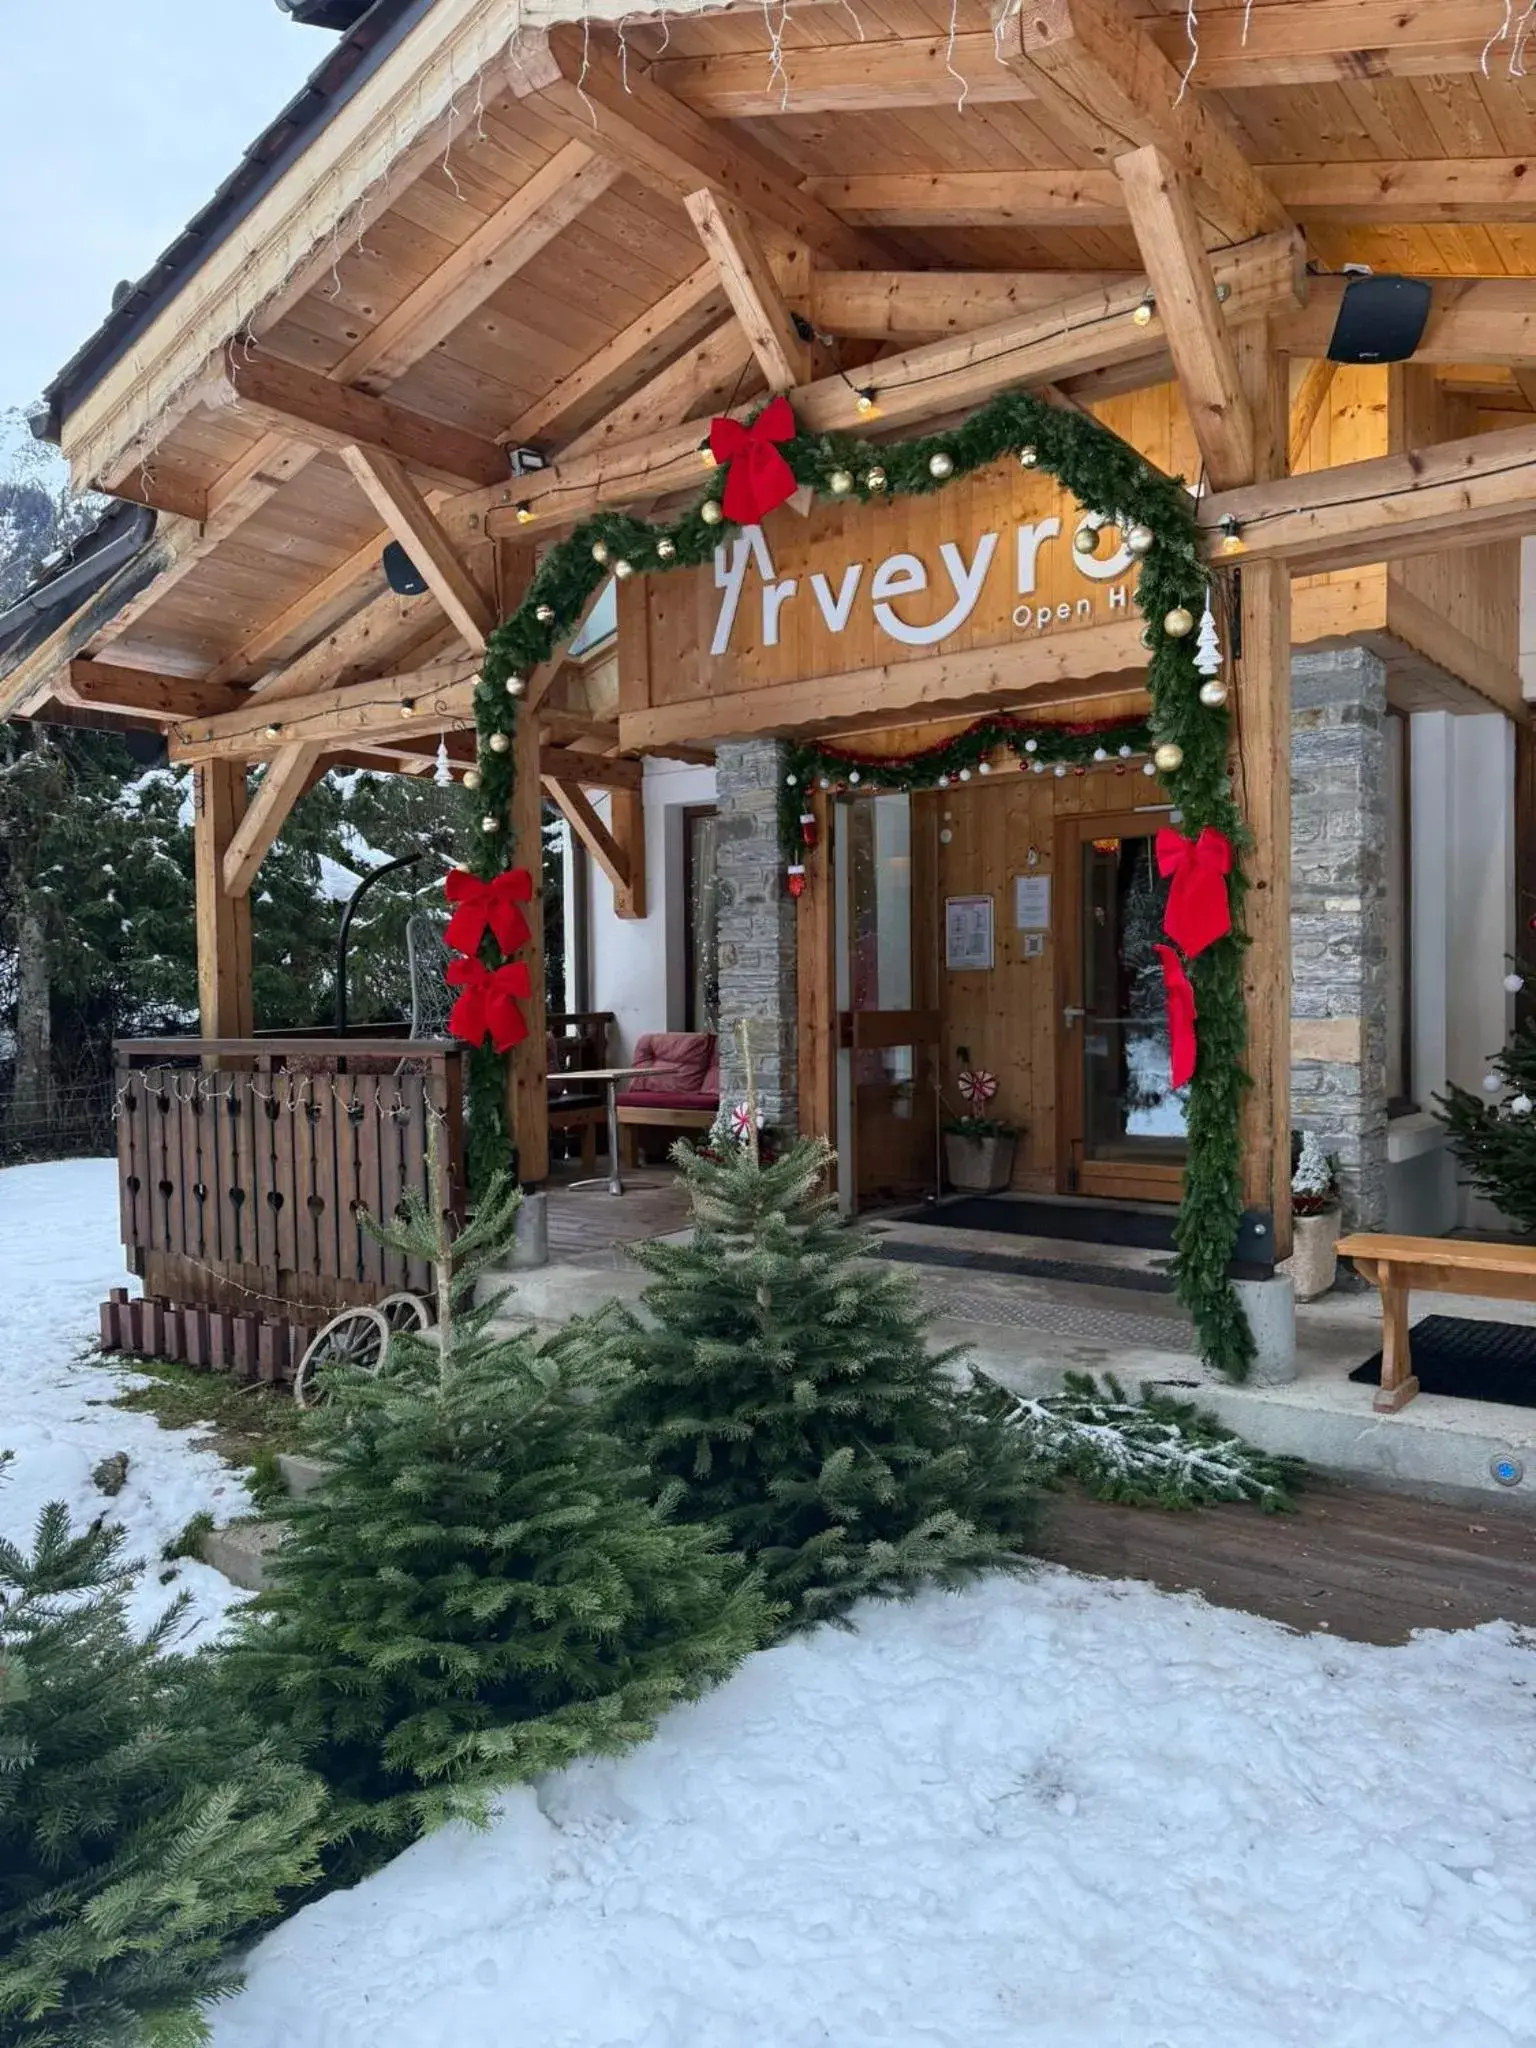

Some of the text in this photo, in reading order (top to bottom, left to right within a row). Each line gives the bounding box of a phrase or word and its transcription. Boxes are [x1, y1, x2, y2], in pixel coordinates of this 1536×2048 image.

[710, 508, 1137, 655] Arveyro
[1013, 585, 1133, 629] Open H
